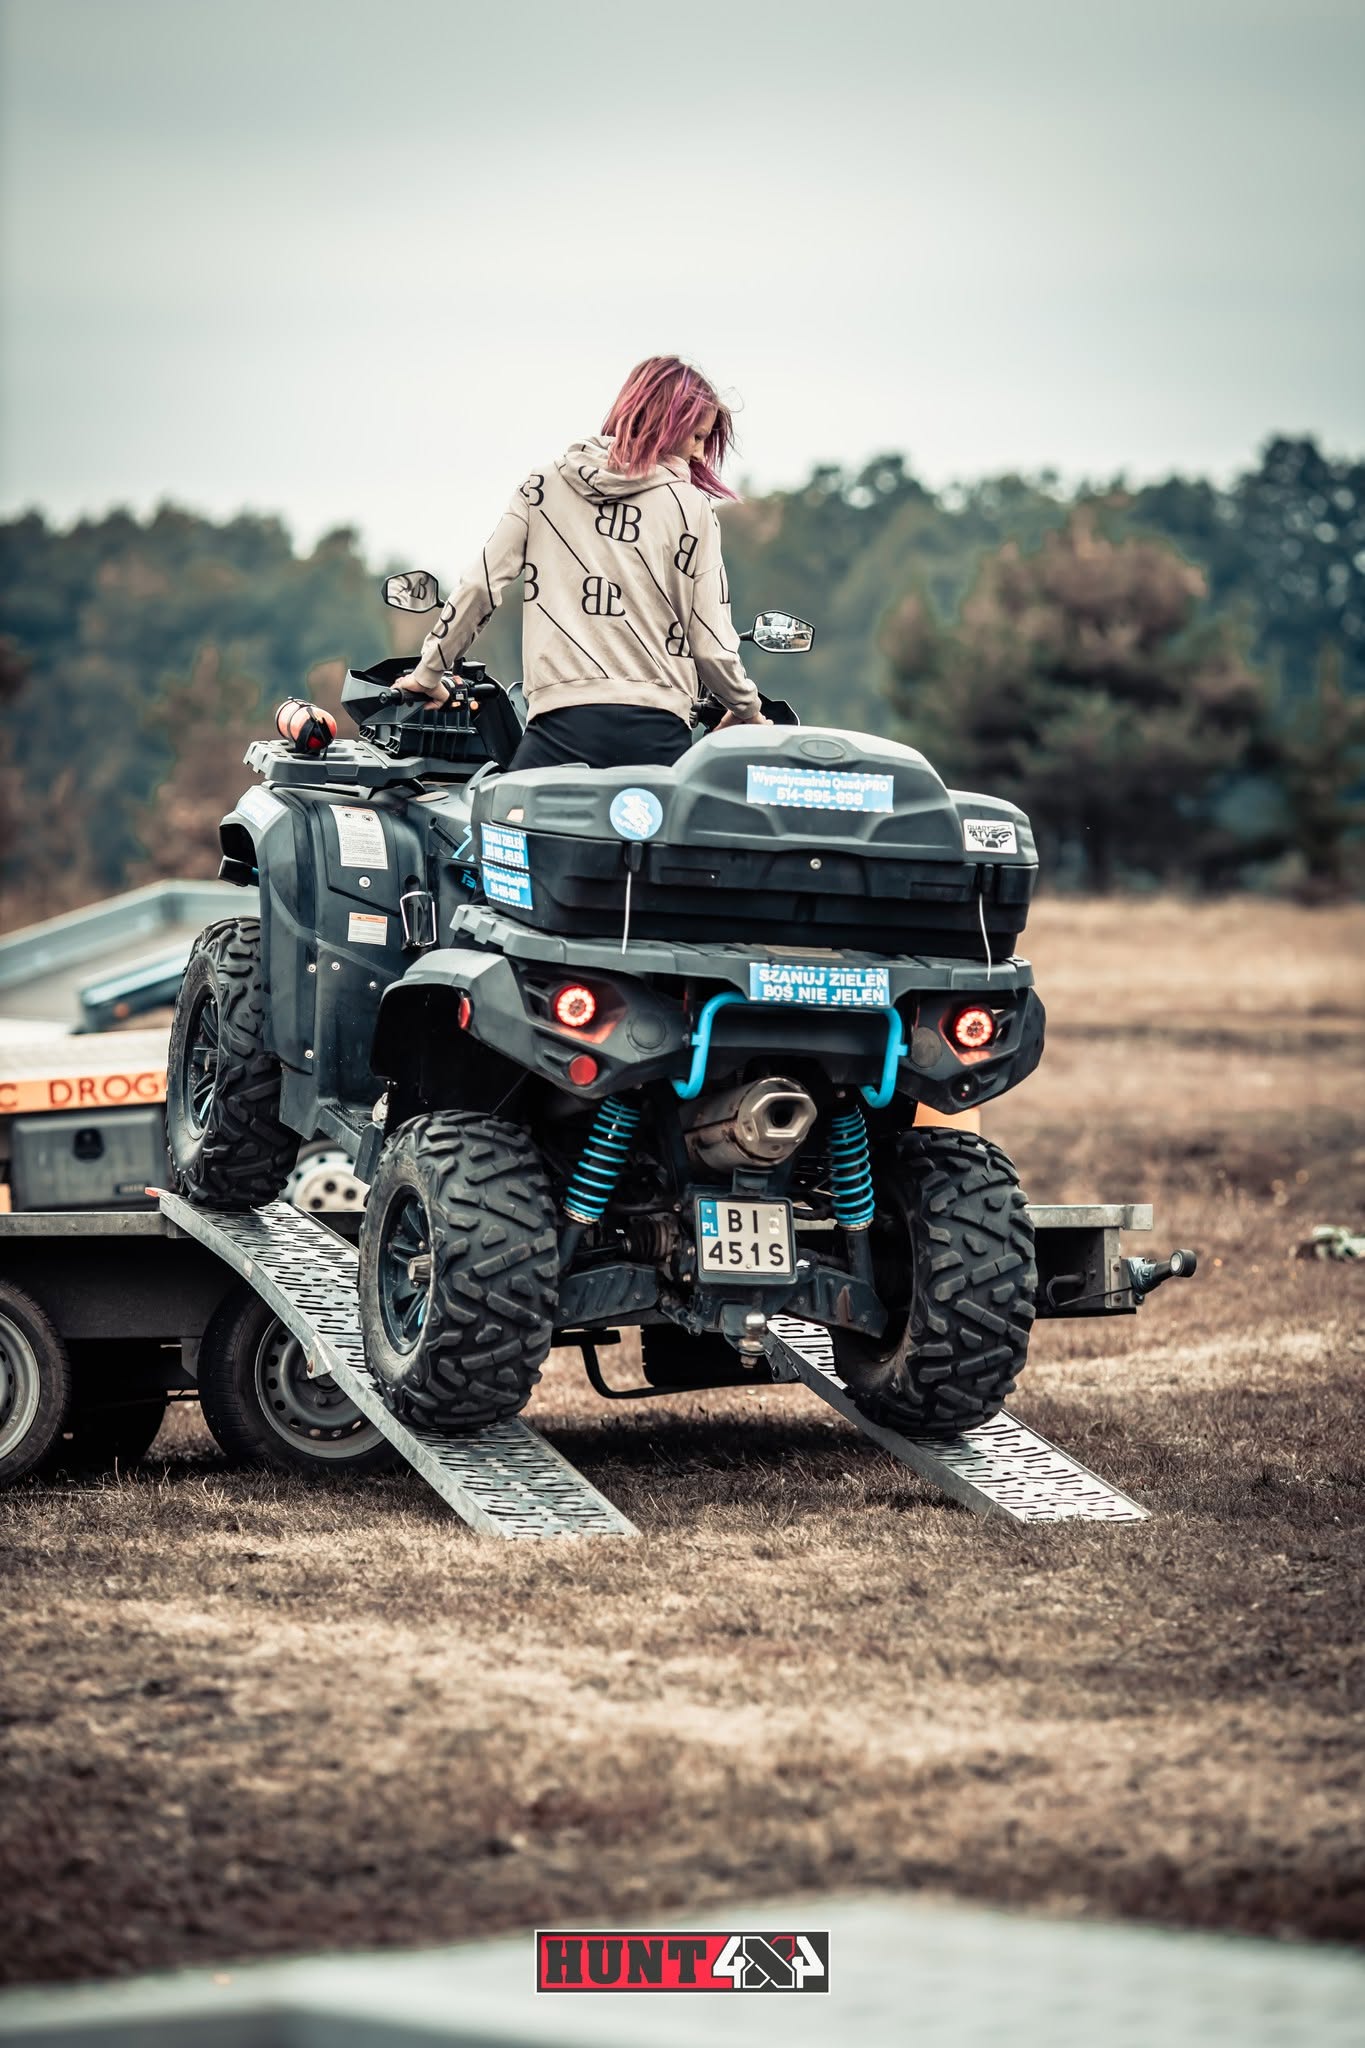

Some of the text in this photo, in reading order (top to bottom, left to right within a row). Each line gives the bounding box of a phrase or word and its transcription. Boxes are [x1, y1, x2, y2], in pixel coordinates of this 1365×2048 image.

[759, 969, 888, 988] SZANUJ ZIELEŃ
[763, 983, 884, 1002] BOŚ NIE JELEŃ
[50, 1073, 166, 1107] DROG
[702, 1221, 718, 1234] PL
[727, 1208, 758, 1234] BI
[708, 1241, 784, 1267] 451S
